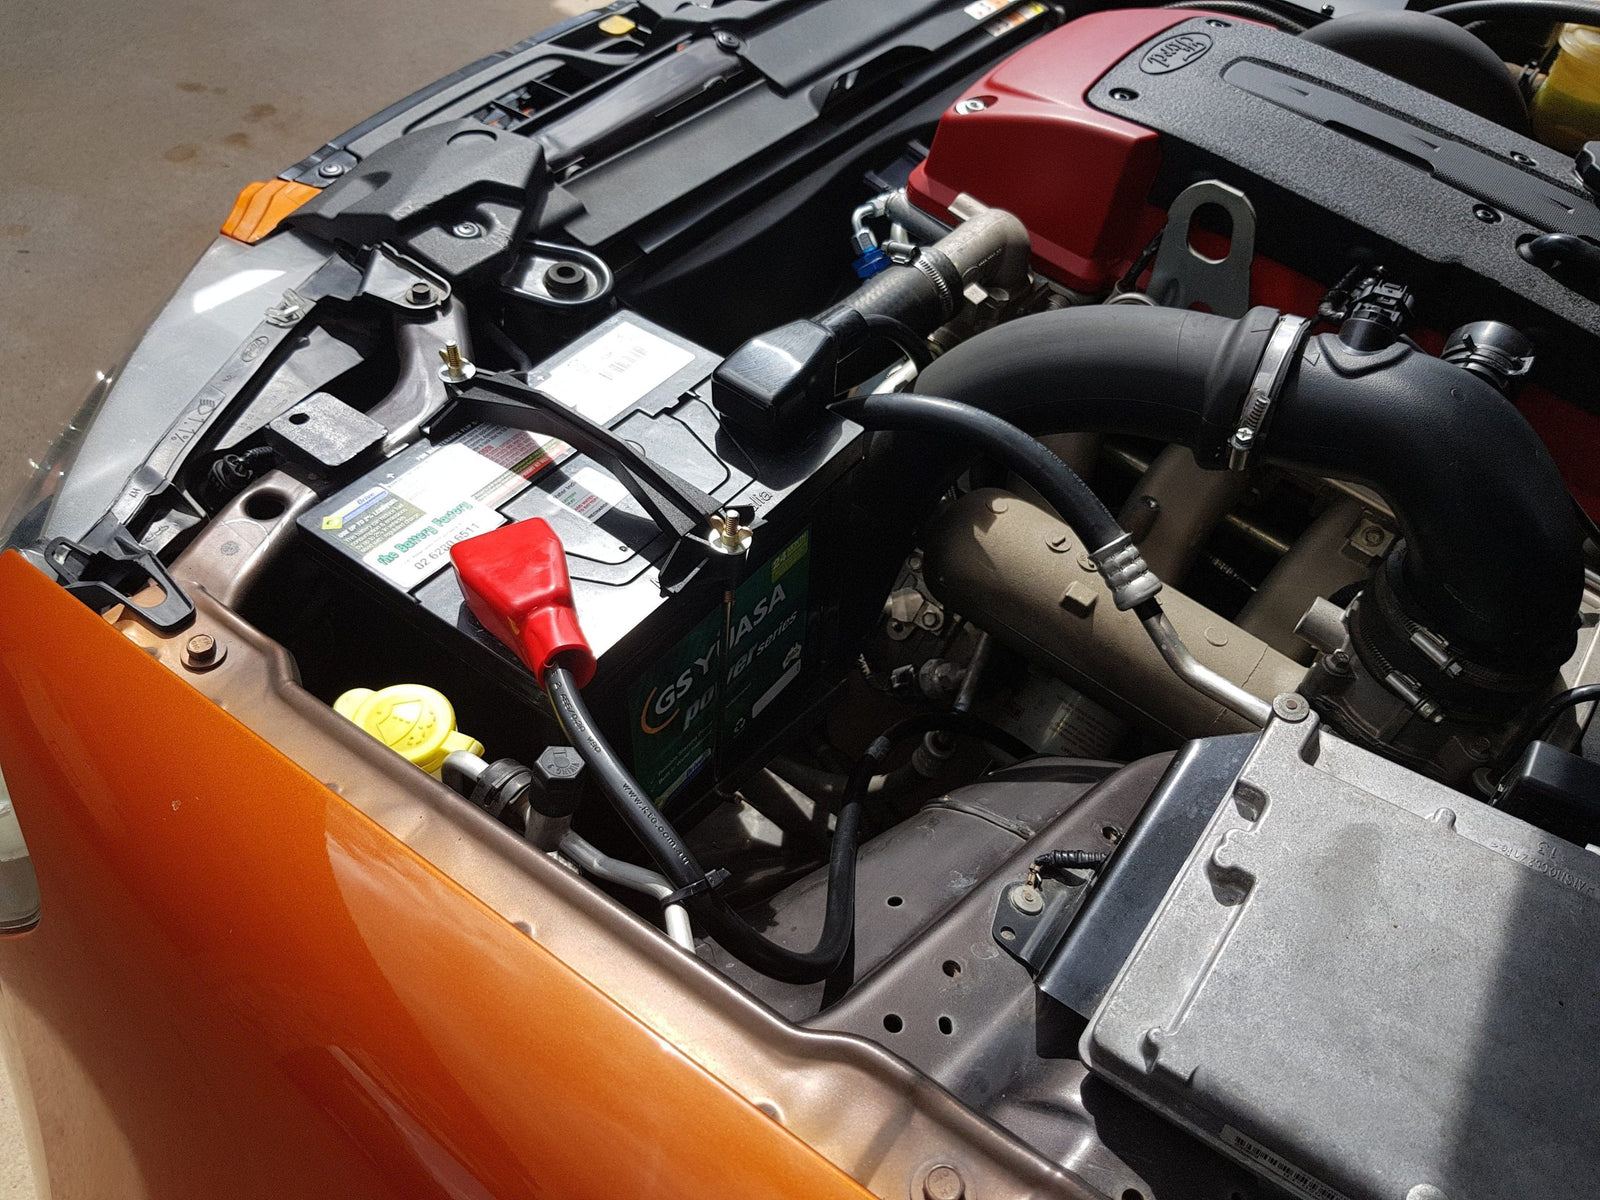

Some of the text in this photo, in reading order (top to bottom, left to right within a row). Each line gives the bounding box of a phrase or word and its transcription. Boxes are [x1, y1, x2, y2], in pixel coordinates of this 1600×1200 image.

[1146, 37, 1206, 68] Ford
[376, 550, 400, 565] the
[393, 526, 439, 553] Battery
[431, 501, 473, 528] Factory
[414, 557, 431, 570] 02
[755, 610, 799, 656] series
[654, 668, 694, 716] GS
